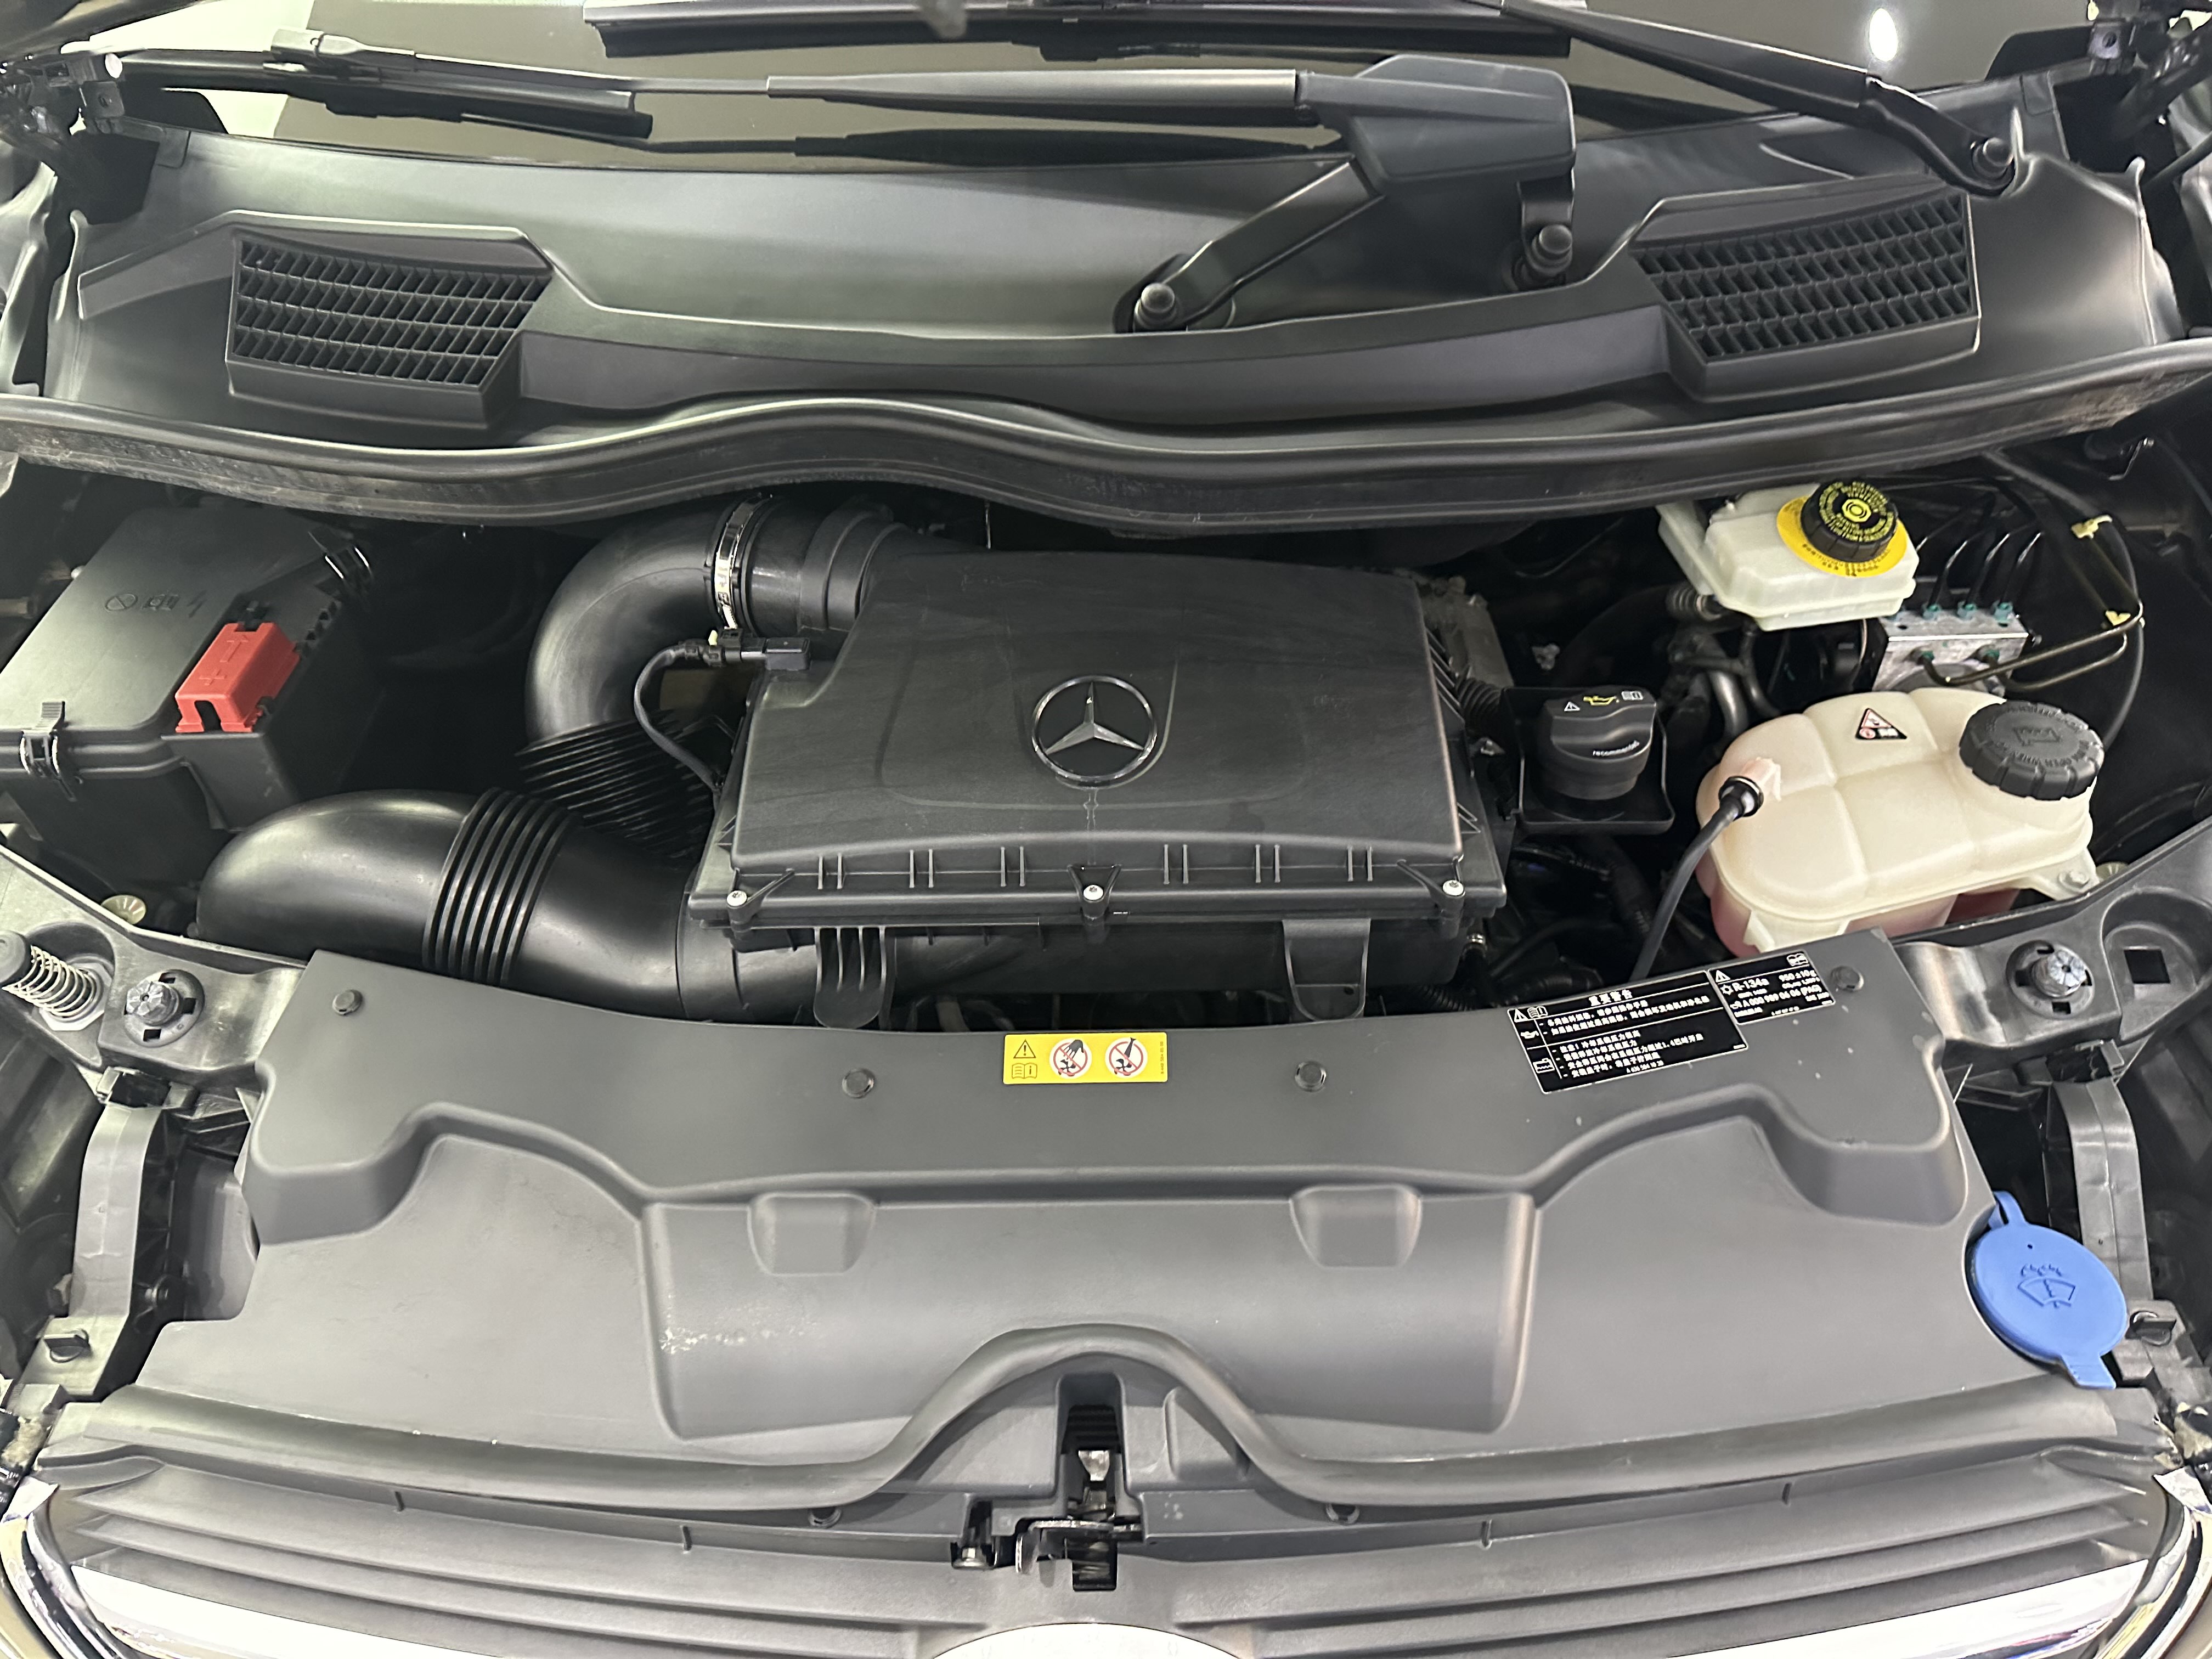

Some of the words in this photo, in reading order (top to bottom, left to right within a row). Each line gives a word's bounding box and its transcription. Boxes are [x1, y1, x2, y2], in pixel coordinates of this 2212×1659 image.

[1732, 978, 1769, 991] R-134a
[1779, 973, 1795, 981] 950
[1588, 989, 1632, 1006] 重要警告
[1749, 997, 1765, 1006] 000
